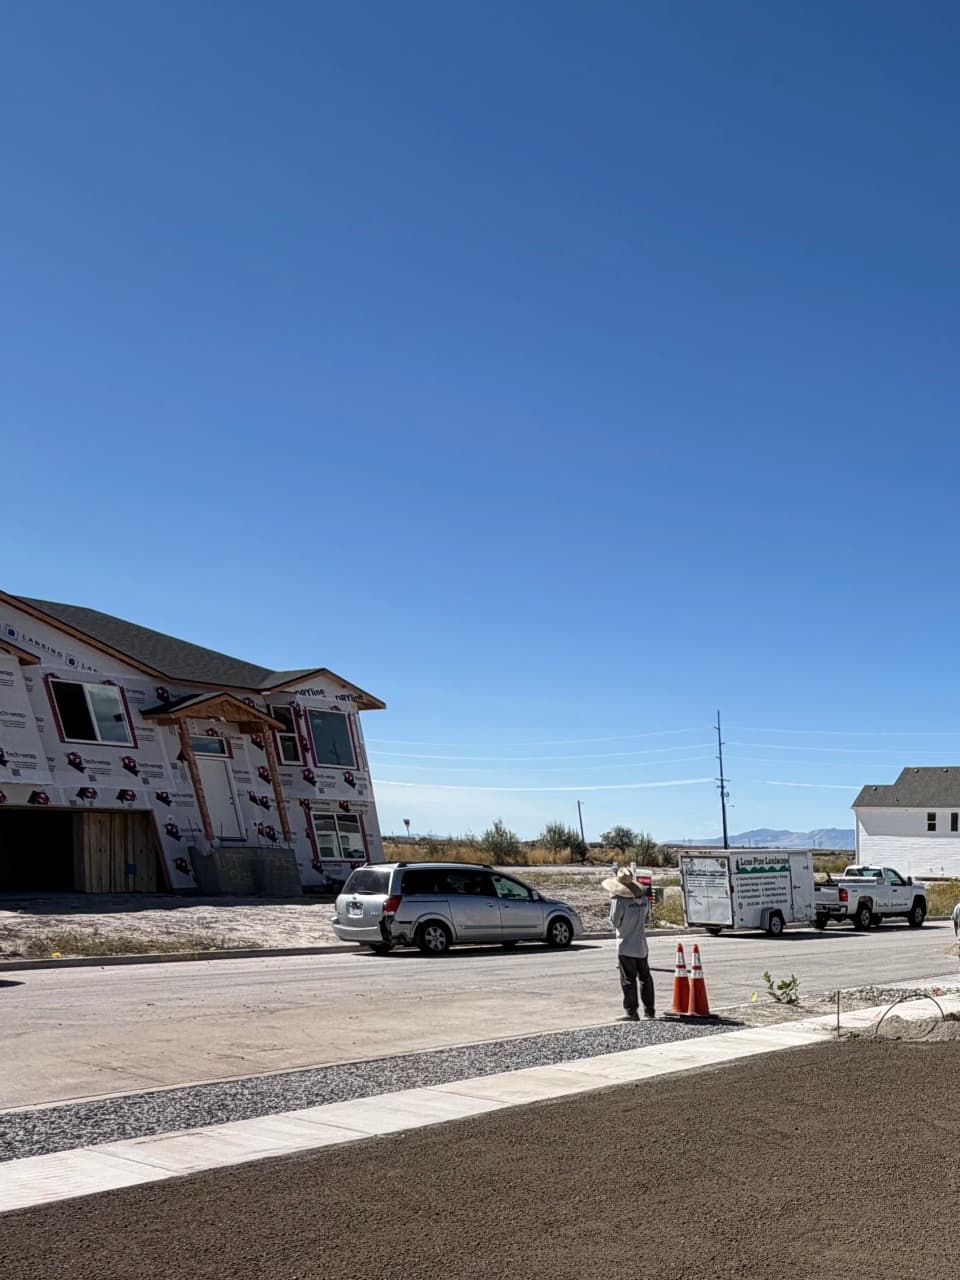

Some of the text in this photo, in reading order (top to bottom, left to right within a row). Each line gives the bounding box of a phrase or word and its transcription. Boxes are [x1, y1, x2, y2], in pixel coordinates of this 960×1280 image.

[22, 634, 63, 657] LANSING
[740, 857, 752, 866] Lone
[753, 856, 764, 865] Pine
